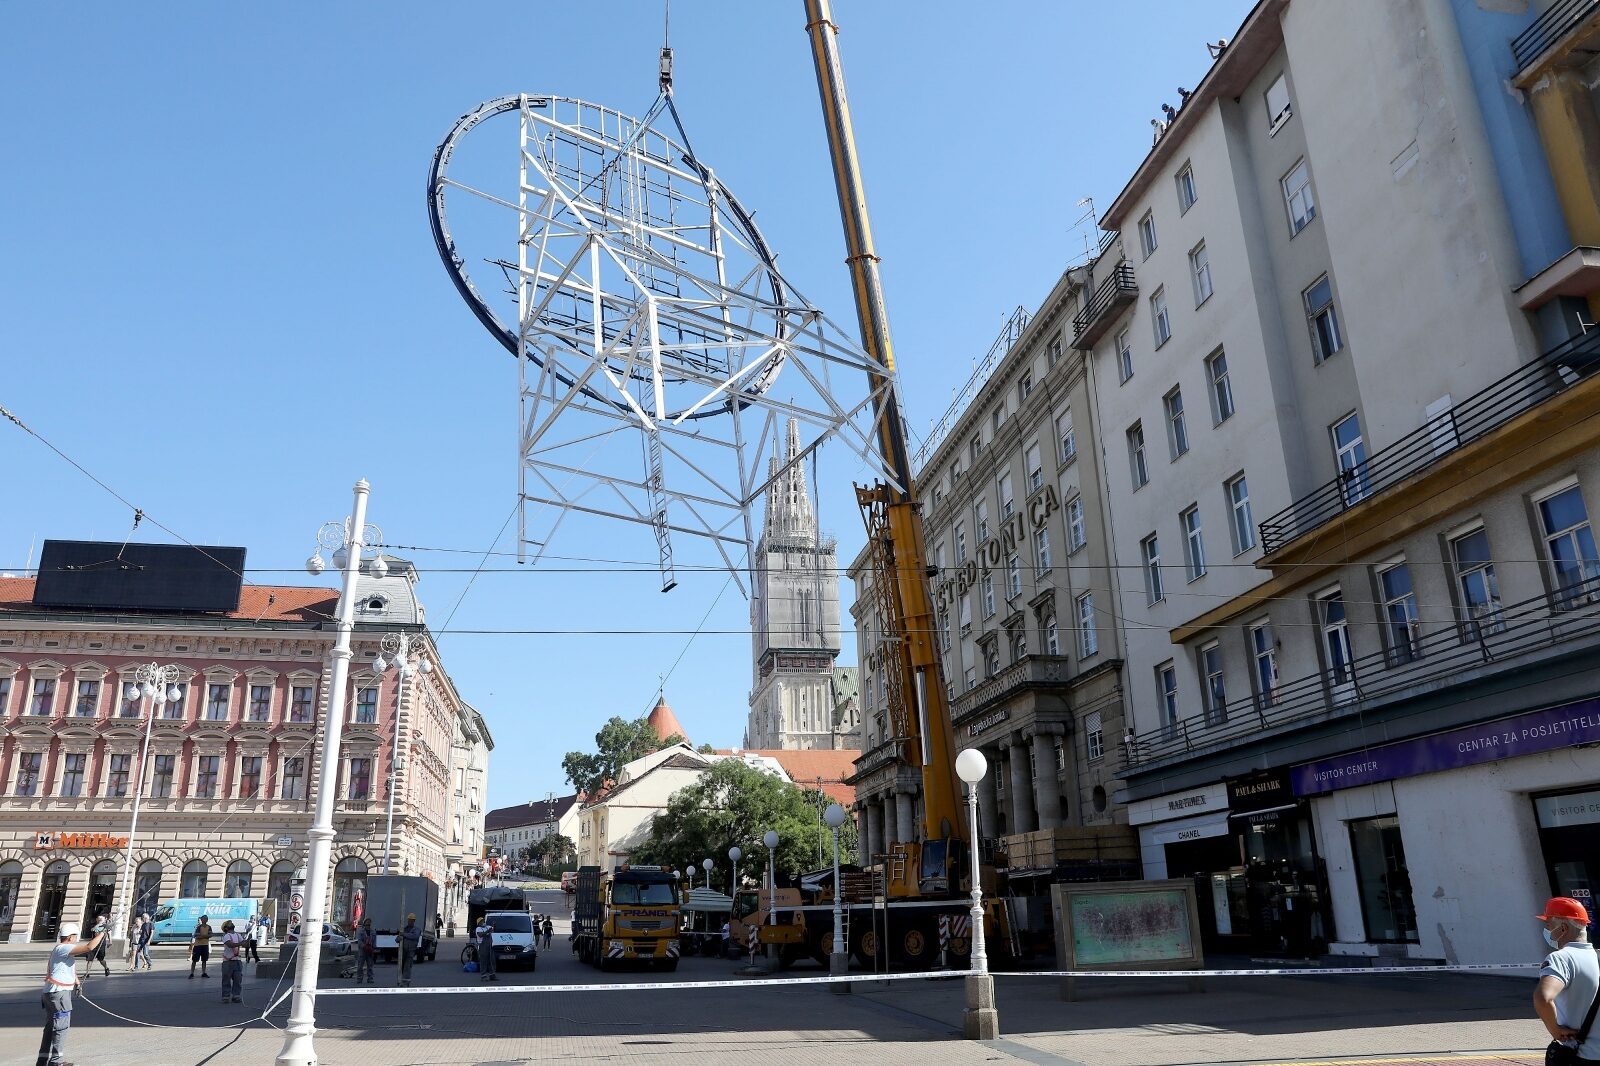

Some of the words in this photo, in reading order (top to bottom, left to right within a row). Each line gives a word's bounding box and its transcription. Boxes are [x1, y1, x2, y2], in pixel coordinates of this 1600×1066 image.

[1458, 733, 1499, 753] CENTAR
[1503, 730, 1519, 744] ZA
[1314, 768, 1344, 782] VISITOR
[1346, 762, 1378, 776] CENTER
[1552, 804, 1585, 817] VISITOR
[58, 832, 130, 849] Müller
[1178, 829, 1201, 840] CHANEL
[623, 908, 671, 917] PRANGL
